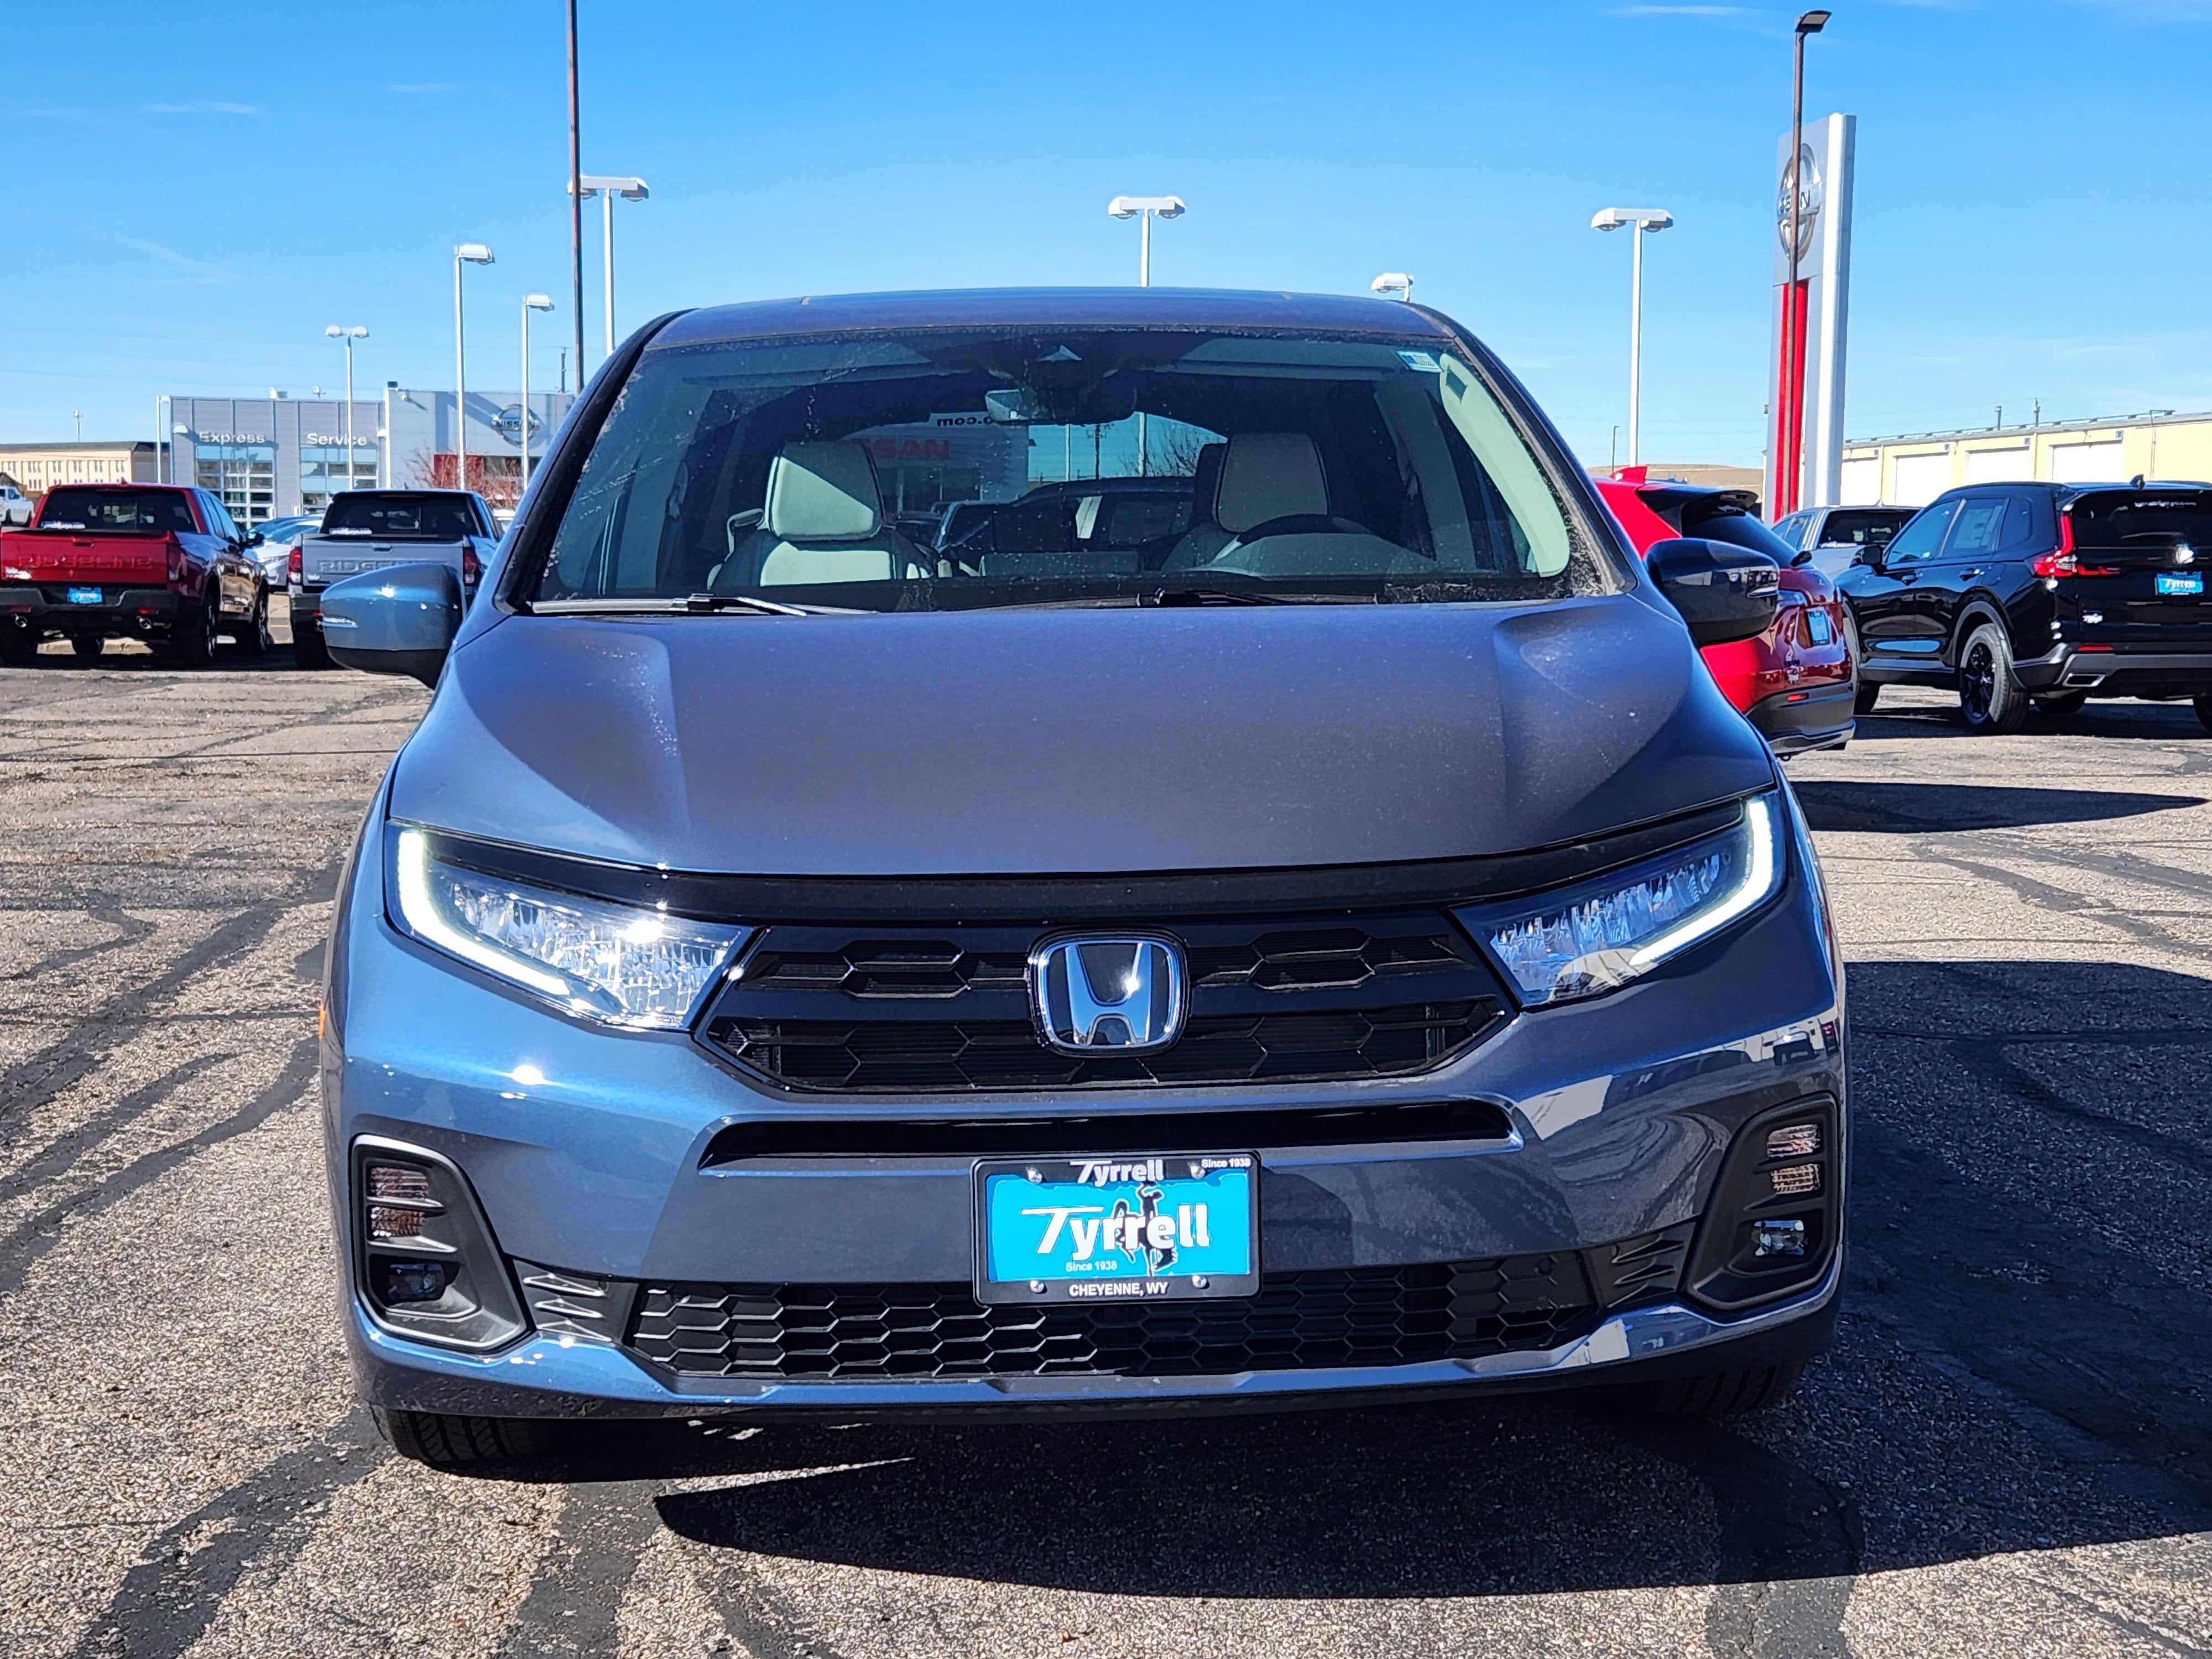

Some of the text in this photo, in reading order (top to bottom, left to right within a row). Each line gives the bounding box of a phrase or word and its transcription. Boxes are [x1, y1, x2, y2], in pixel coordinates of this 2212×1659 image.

[199, 431, 265, 445] Express
[1201, 1159, 1227, 1168] Since
[1070, 1159, 1165, 1187] Tyrrell
[1020, 1203, 1210, 1261] Tyrrell
[1066, 1260, 1118, 1272] Since 1938
[1069, 1281, 1169, 1297] CHEYENNE, WY
